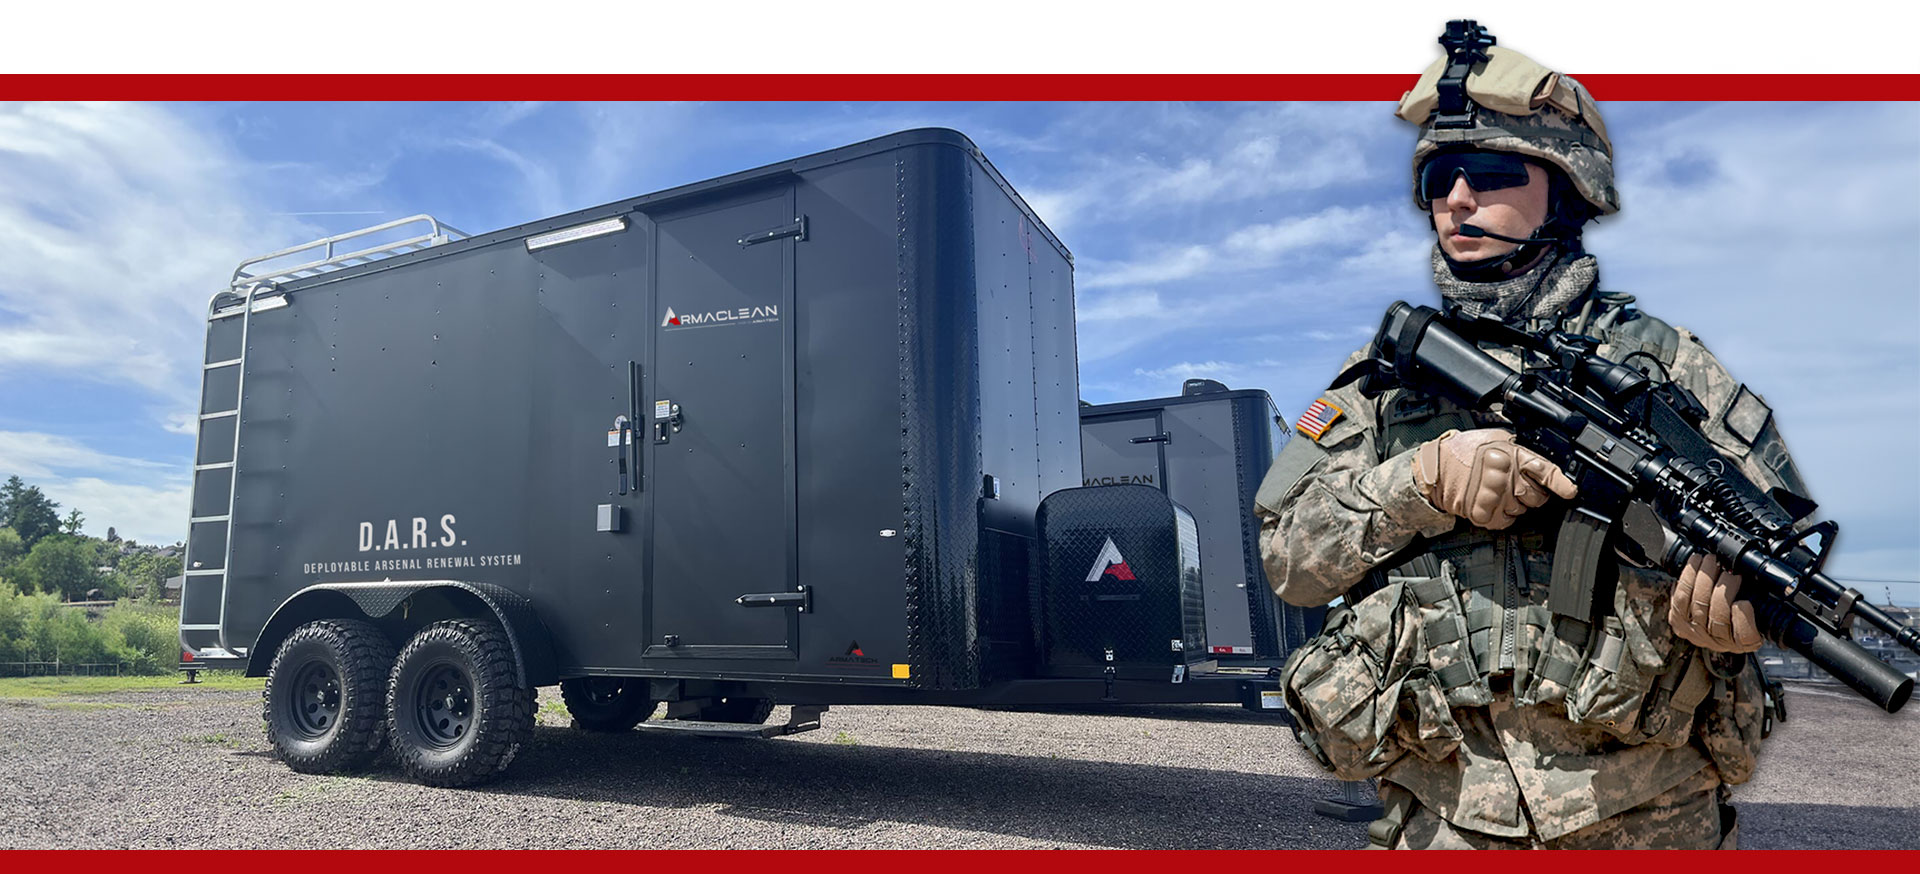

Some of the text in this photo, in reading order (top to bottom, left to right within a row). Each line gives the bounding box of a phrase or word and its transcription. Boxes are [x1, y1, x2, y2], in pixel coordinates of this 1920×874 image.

[661, 305, 778, 327] ARMACLEAN
[1082, 474, 1153, 488] MACLEAN
[359, 514, 467, 552] D.A.R.S.
[304, 554, 522, 574] DEPLOYABLE ARSENAL RENEWAL SYSTEM
